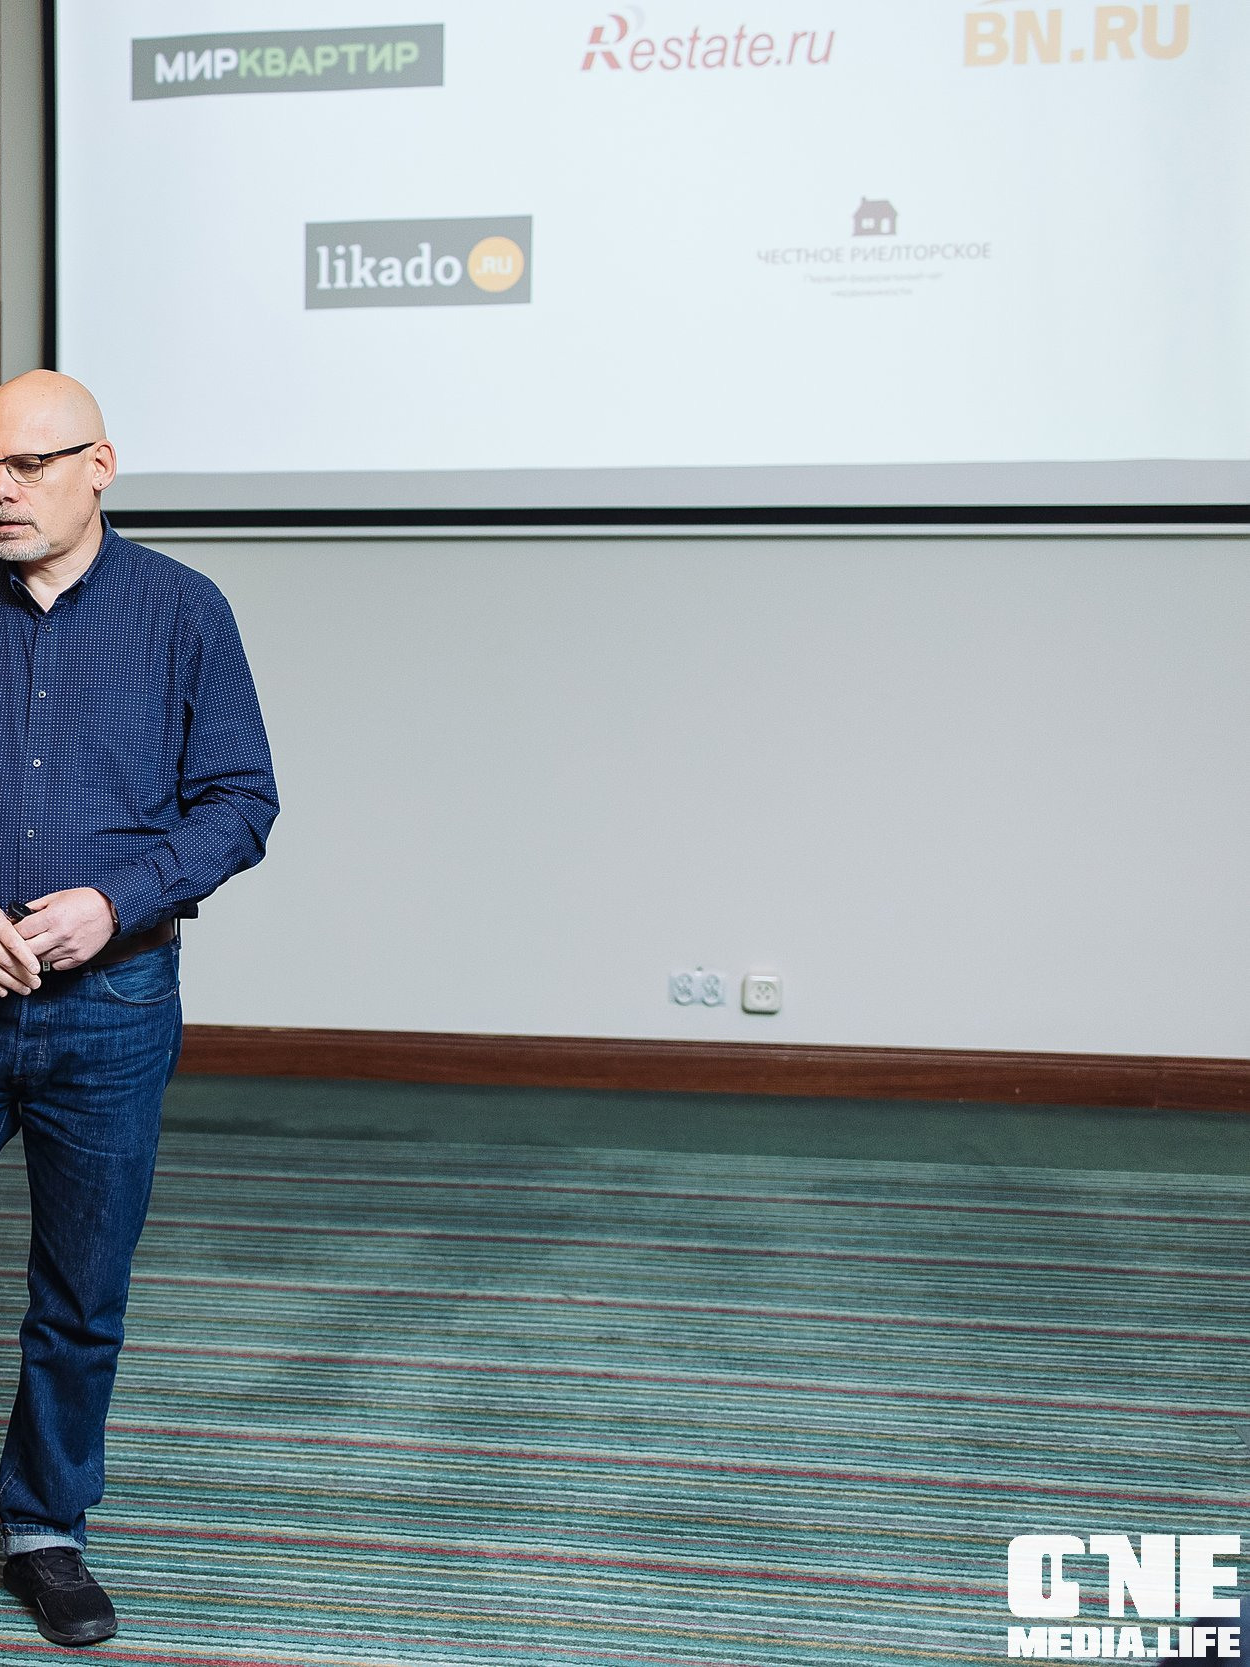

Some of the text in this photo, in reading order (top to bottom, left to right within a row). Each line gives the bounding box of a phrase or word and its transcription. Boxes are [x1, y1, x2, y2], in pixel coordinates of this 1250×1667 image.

[582, 14, 835, 71] Restate.ru
[963, 4, 1190, 67] BN.RU
[155, 41, 419, 83] МИРКВАРТИР
[316, 242, 463, 289] likado
[756, 243, 992, 265] ЧЕСТНОЕ РИЕЛТОРСКОЕ
